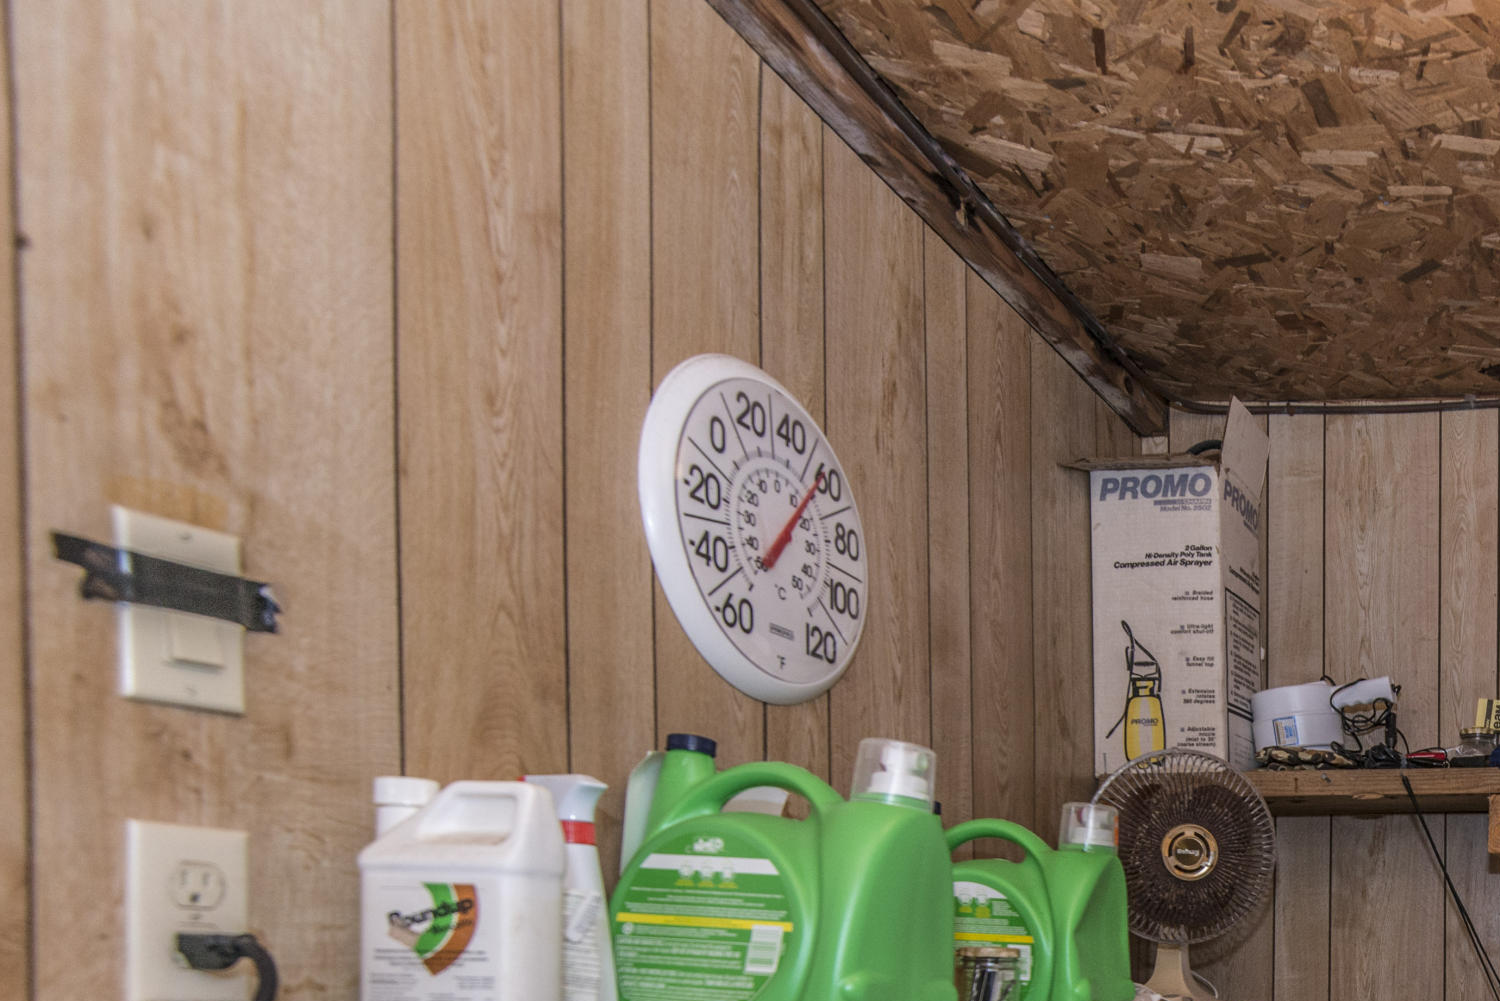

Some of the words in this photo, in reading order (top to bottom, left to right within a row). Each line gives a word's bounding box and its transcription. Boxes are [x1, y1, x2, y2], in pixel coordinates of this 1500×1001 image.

[736, 391, 766, 438] 20
[776, 413, 807, 455] 40
[710, 416, 726, 454] 0
[815, 462, 841, 502] 60
[1099, 473, 1212, 501] PROMO
[1223, 479, 1260, 530] PROMO
[834, 522, 860, 562] 80
[1179, 551, 1195, 559] Poly
[1113, 559, 1165, 569] Compressed
[1166, 558, 1179, 567] Air
[1179, 558, 1213, 568] Sprayer
[829, 578, 860, 620] 100
[804, 622, 838, 665] 120
